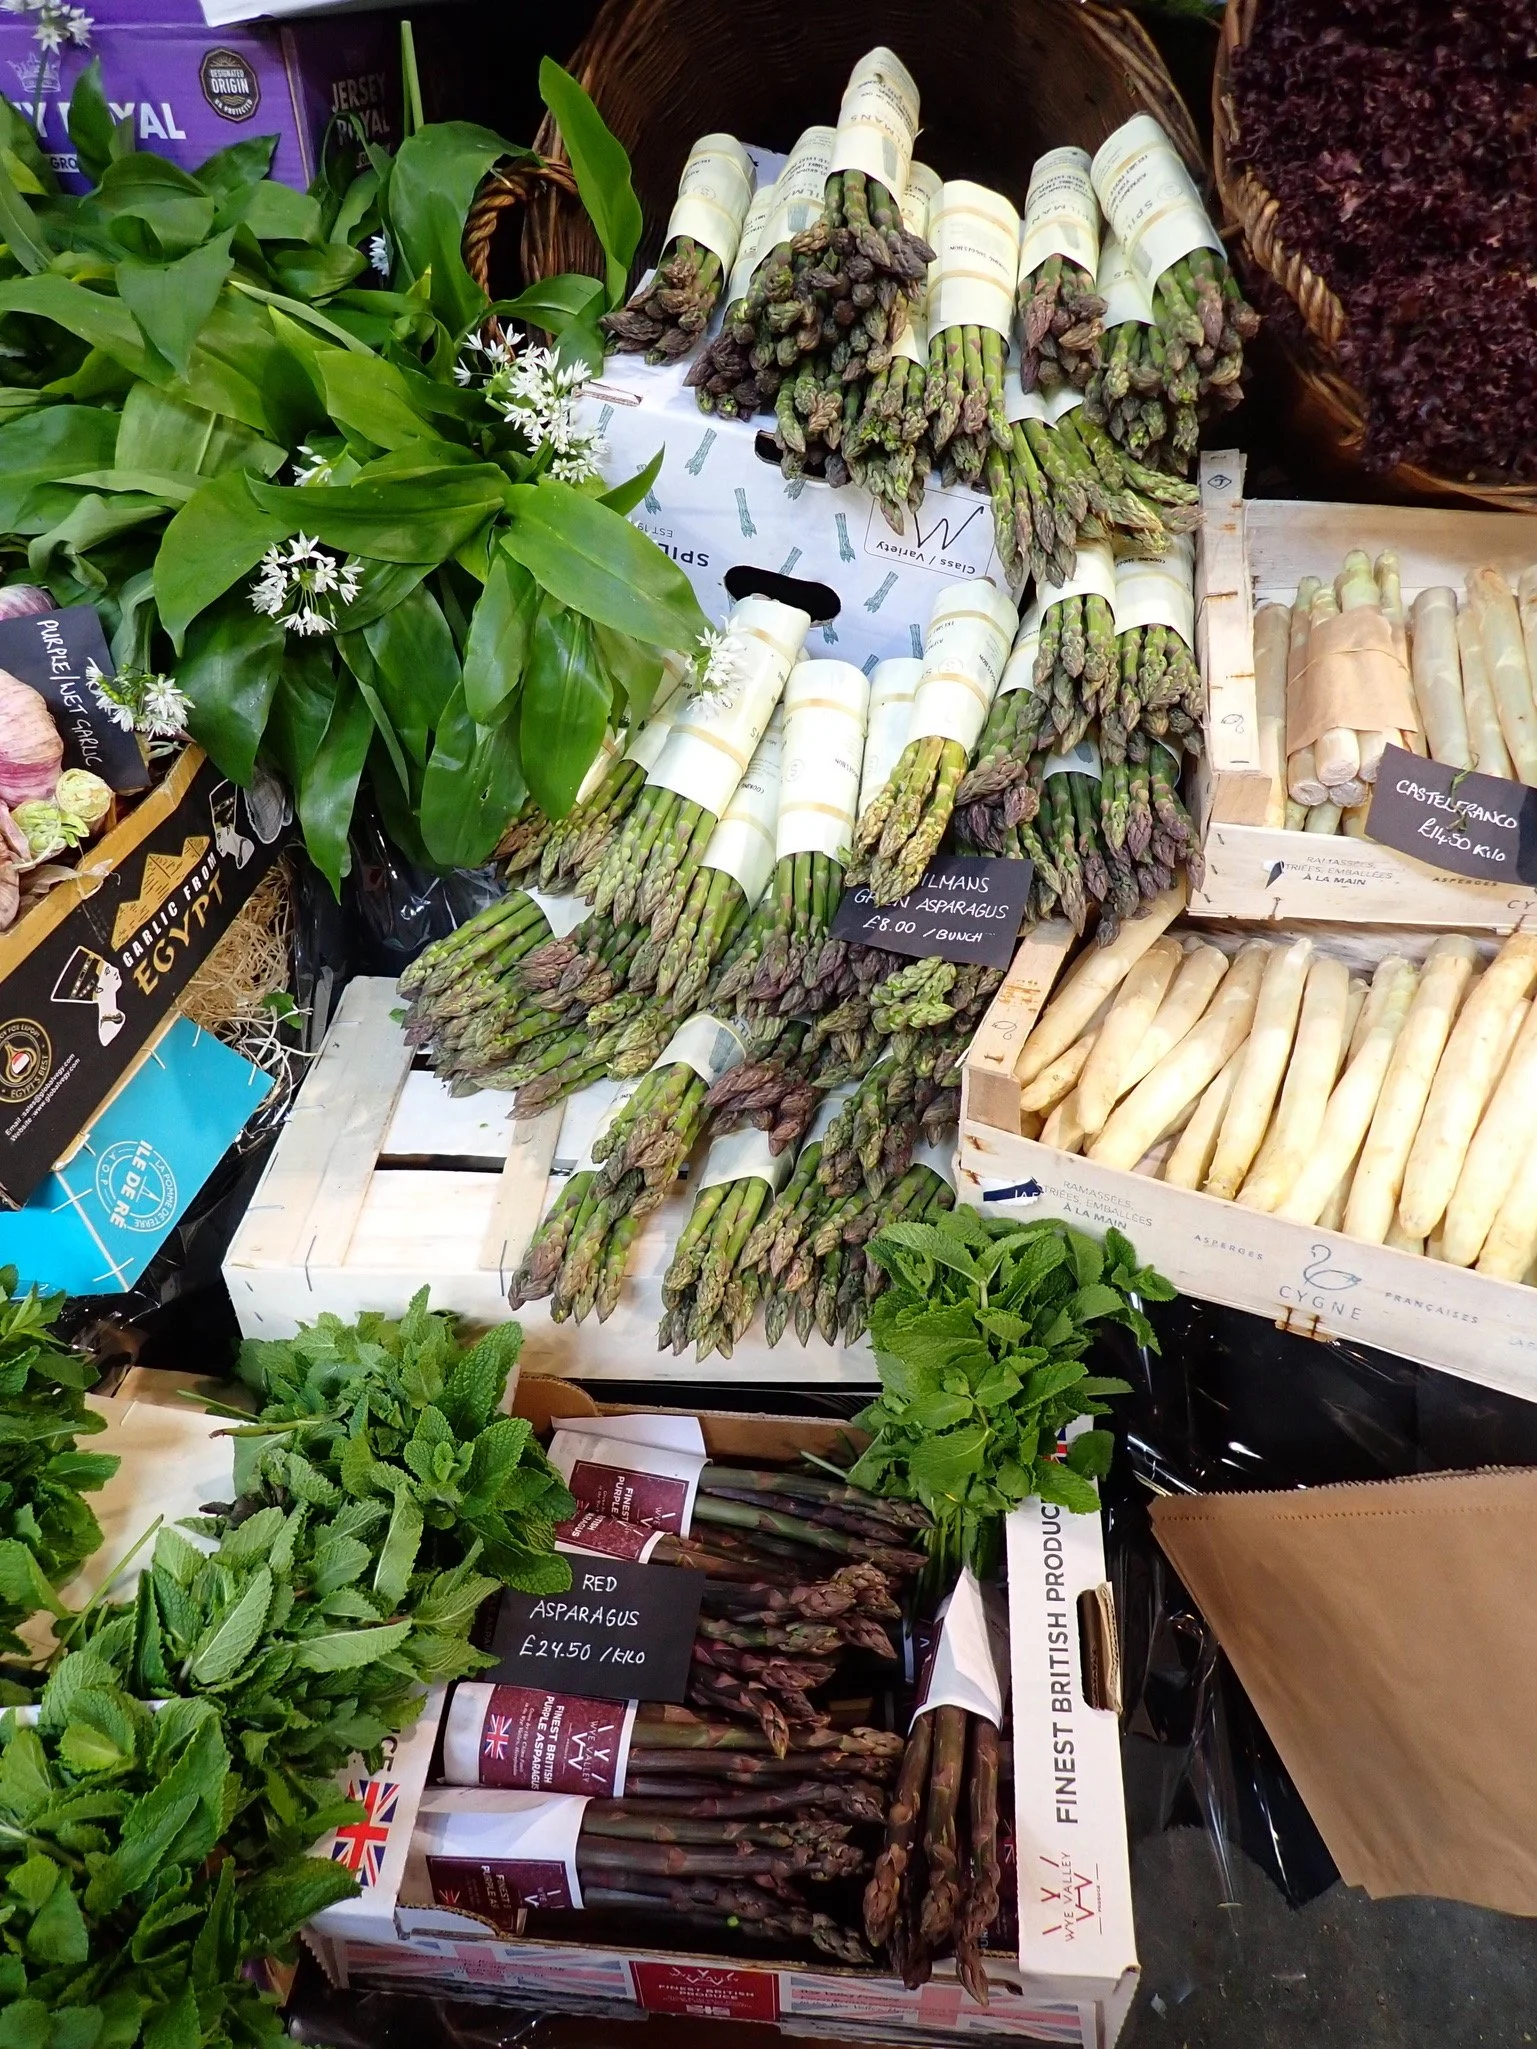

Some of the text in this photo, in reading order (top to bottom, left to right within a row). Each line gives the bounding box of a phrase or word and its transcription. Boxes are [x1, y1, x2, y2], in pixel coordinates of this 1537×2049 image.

[210, 69, 244, 78] DESIGNATED
[211, 78, 249, 94] ORIGIN
[332, 72, 386, 114] JERSEY
[336, 106, 391, 146] RYAL
[652, 527, 674, 538] EST
[658, 543, 710, 567] SPIL
[876, 541, 925, 561] Variety
[940, 558, 976, 575] Class
[71, 718, 104, 767] GARLIC
[1396, 779, 1518, 829] CASTELFRANCO
[1315, 875, 1330, 883] LA
[1333, 877, 1367, 886] MAIN
[1432, 877, 1498, 888] ASPERGES
[122, 852, 217, 968] GARLIC FROM
[854, 889, 1009, 920] GRN ASPARAGUS
[133, 868, 223, 996] EGYPT
[863, 914, 916, 934] £8.00
[10, 1055, 49, 1098] EGYPT'S BEST
[5, 1116, 22, 1136] Email
[10, 1117, 32, 1142] Website
[121, 1171, 141, 1200] DE
[135, 1160, 173, 1228] LA POMME DE TERRE
[1063, 1202, 1127, 1230] À LA MAIN
[1086, 1199, 1153, 1227] EMBALLÉES
[1193, 1234, 1264, 1260] ASPERGES
[1279, 1285, 1362, 1321] CYGNE
[1385, 1292, 1479, 1324] FRANÇAISES
[611, 1475, 626, 1514] PURPLE
[621, 1487, 634, 1521] FINEST
[583, 1573, 618, 1592] RED
[529, 1600, 640, 1627] ASPARAGUS
[519, 1634, 591, 1661] £24.50
[1041, 1504, 1078, 1825] FINEST BRITISH PRODUC
[530, 1695, 555, 1790] PURPLE ASPARAGUS
[543, 1705, 565, 1784] FINEST BRITISH
[582, 1721, 599, 1783] WYE VALLEY
[481, 1865, 496, 1897] PURPLE
[496, 1874, 509, 1904] FINEST
[1061, 1852, 1075, 1942] WYE VALLEY
[659, 1984, 754, 1997] FINEST BRITISH
[680, 1991, 738, 2000] PRODUCE
